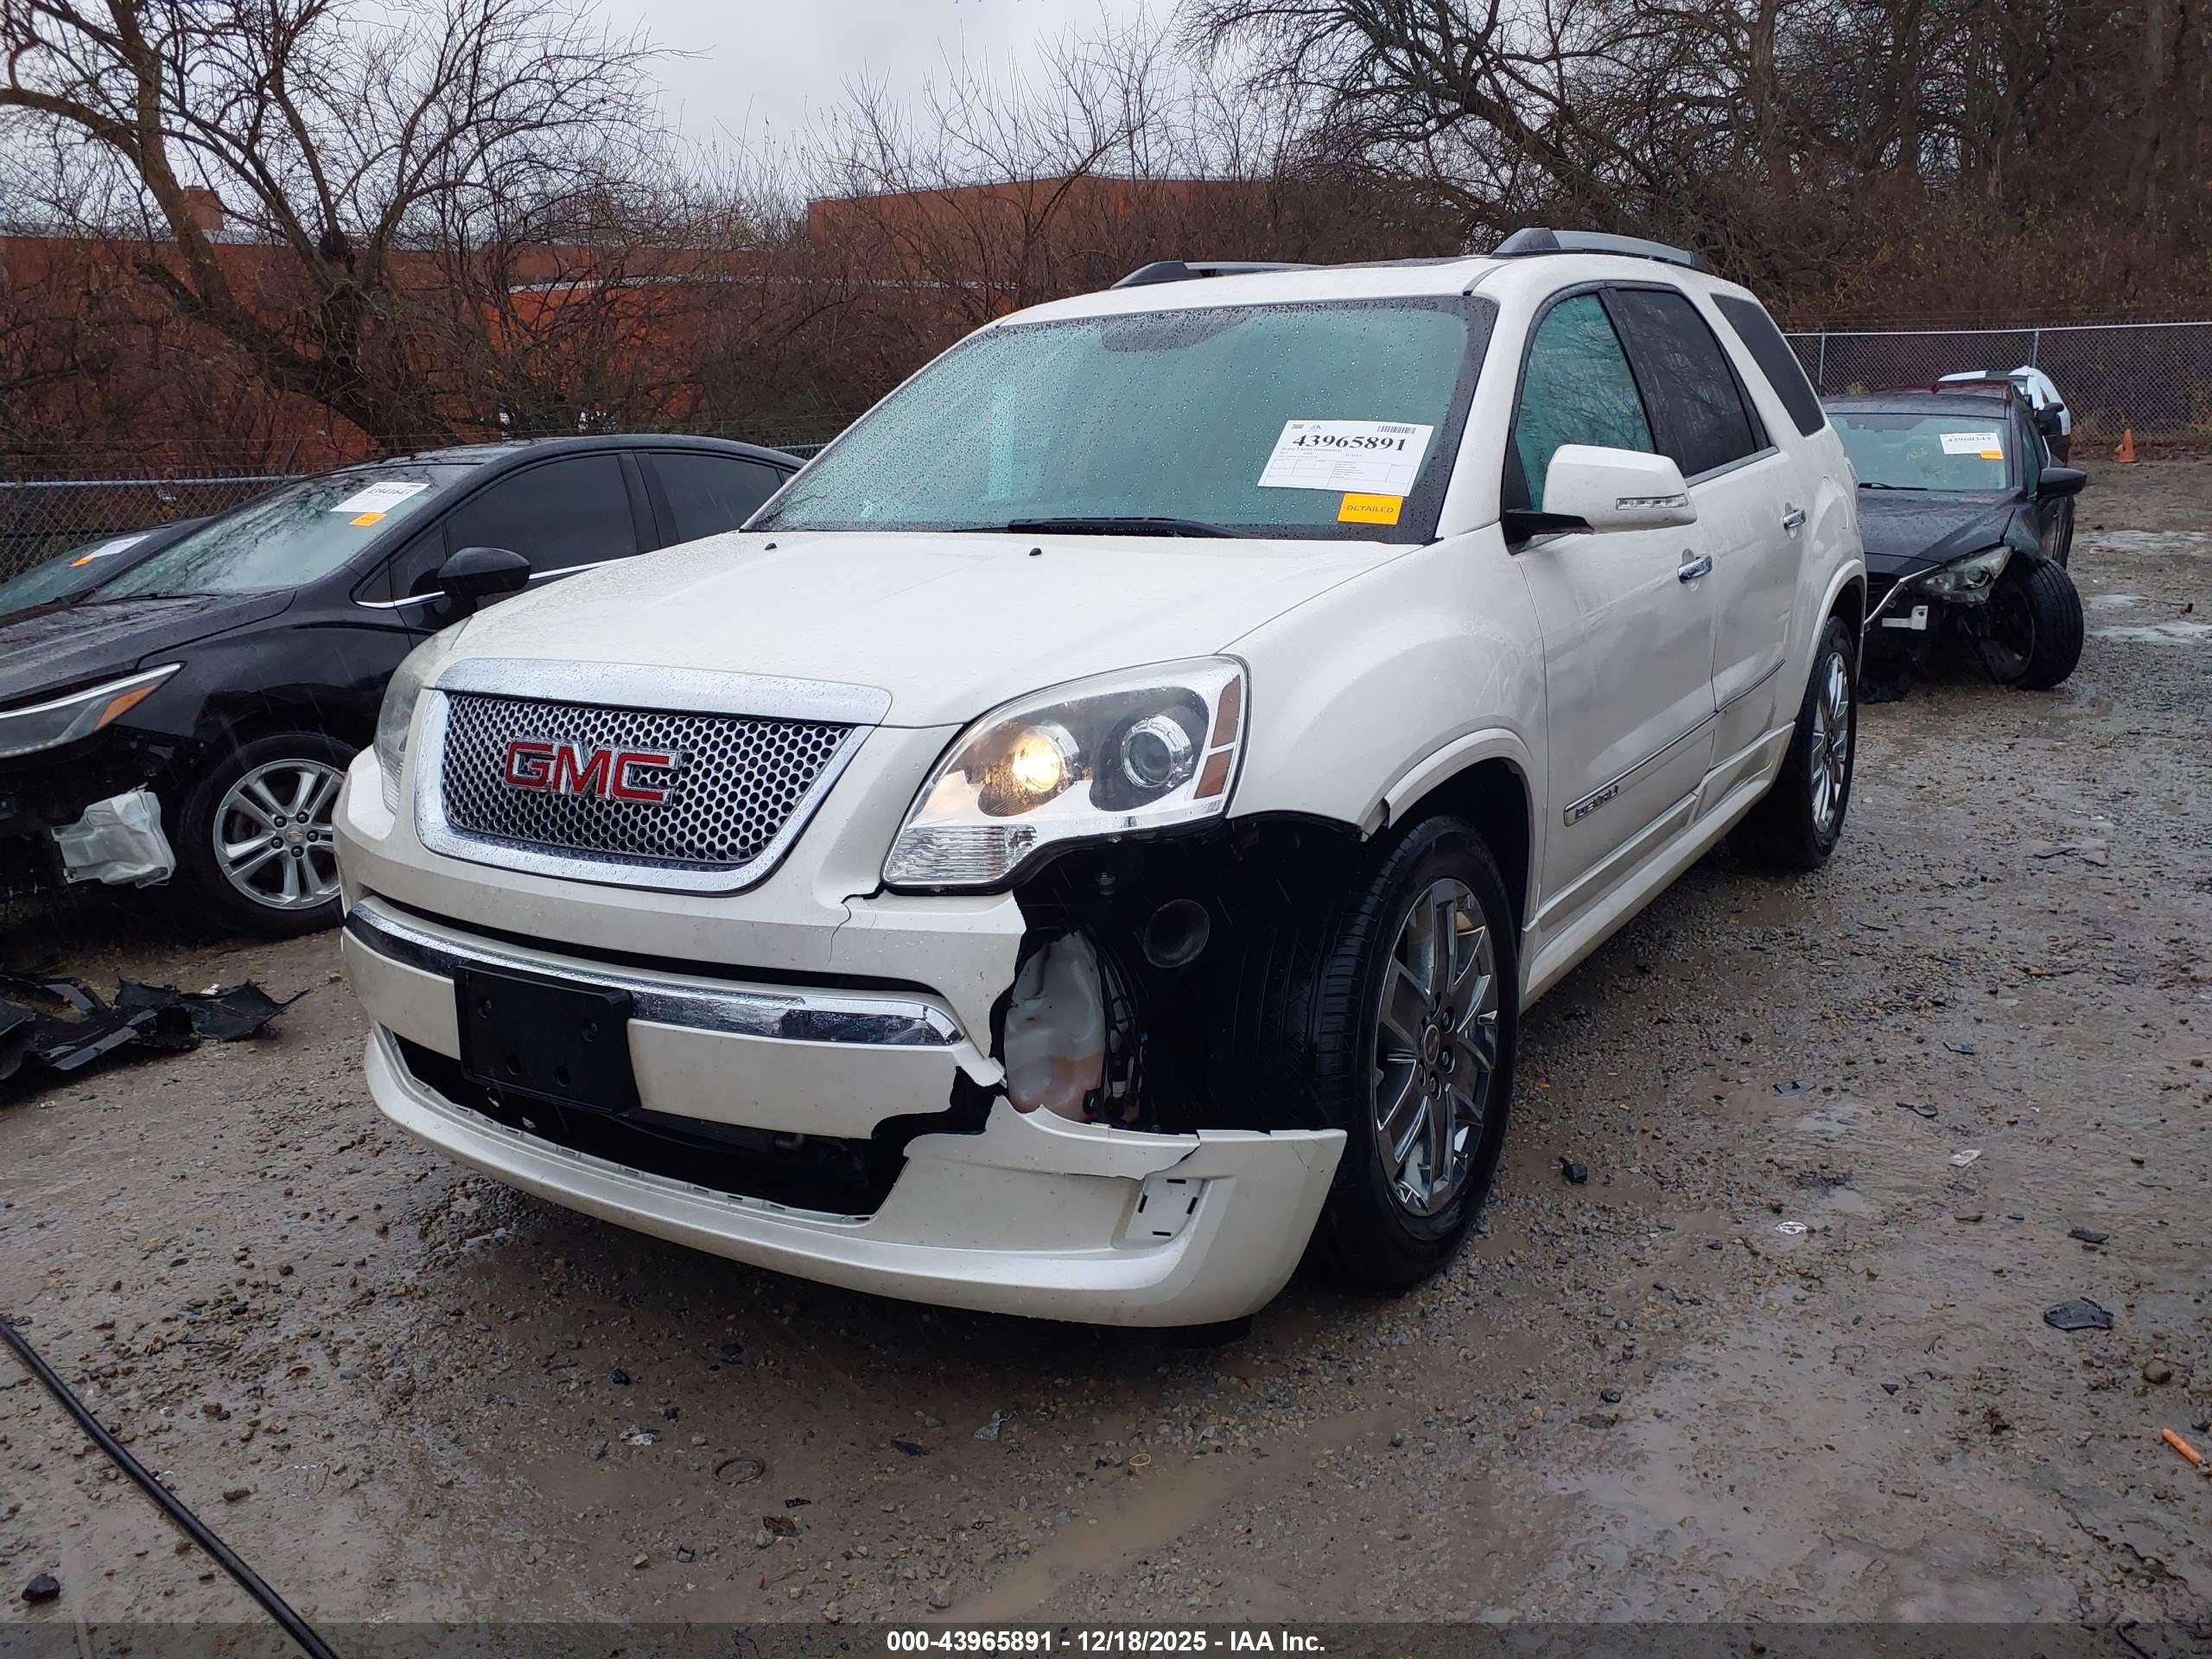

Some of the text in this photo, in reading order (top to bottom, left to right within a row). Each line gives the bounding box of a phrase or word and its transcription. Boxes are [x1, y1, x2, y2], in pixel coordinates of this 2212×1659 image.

[1292, 434, 1406, 451] 43965891
[1346, 505, 1395, 514] DETAILED
[504, 741, 676, 804] GMC
